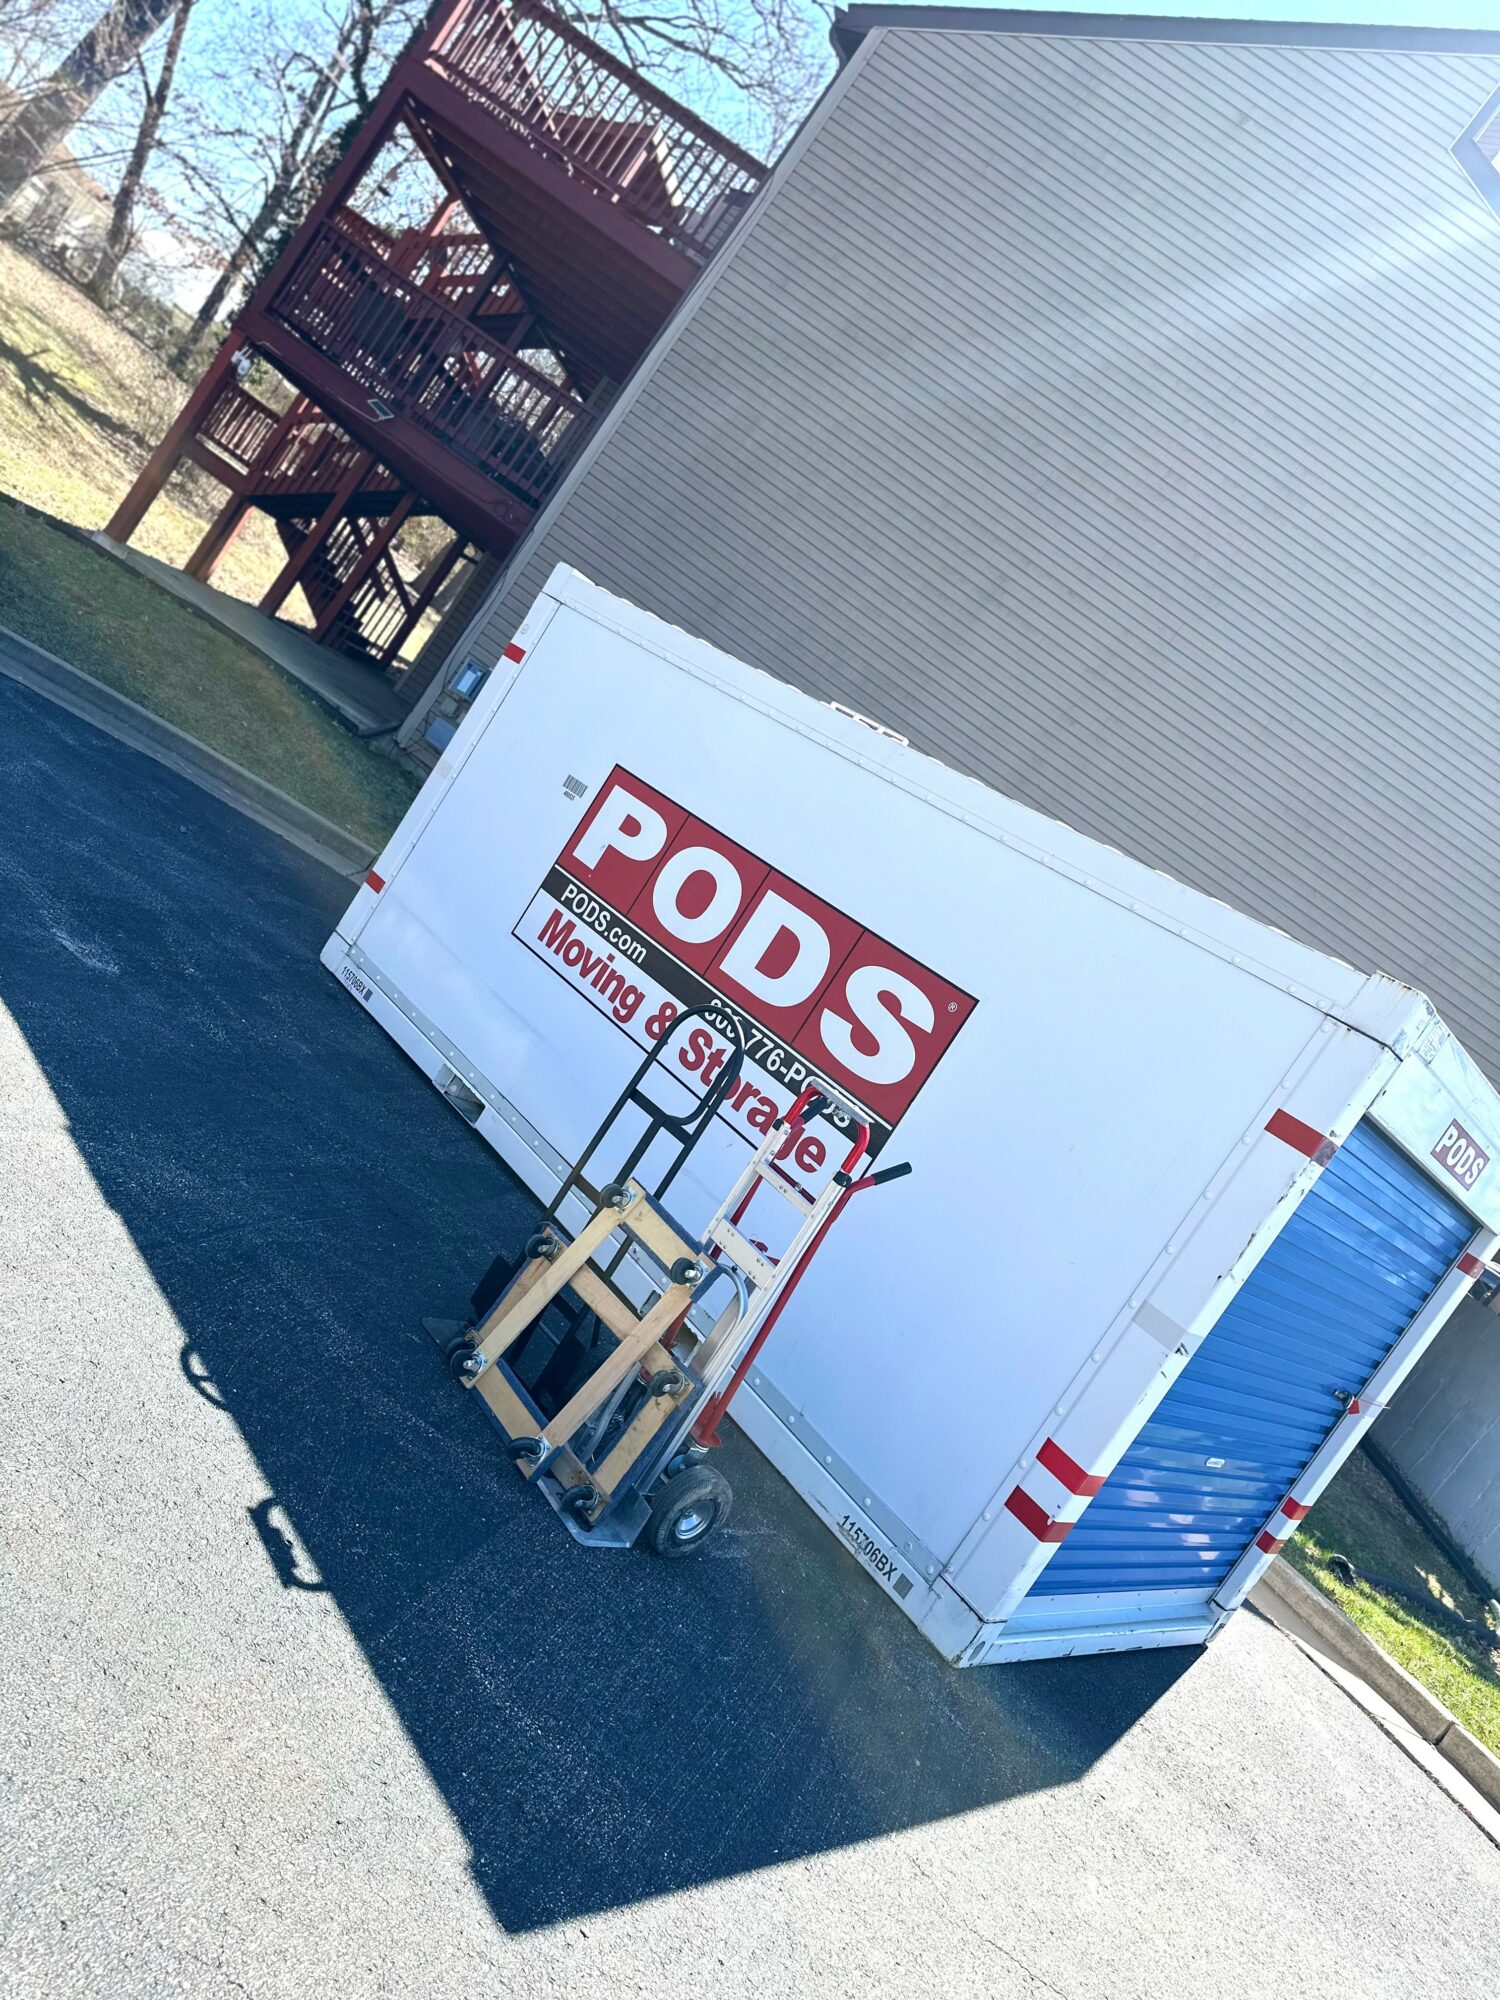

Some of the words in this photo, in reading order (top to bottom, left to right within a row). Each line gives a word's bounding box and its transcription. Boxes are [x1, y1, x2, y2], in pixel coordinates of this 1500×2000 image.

[560, 883, 647, 964] PODS.com
[572, 784, 935, 1086] PODS
[341, 966, 367, 995] 115706BX
[536, 908, 646, 1024] Moving
[645, 1001, 678, 1041] &
[1434, 1124, 1485, 1185] PODS
[840, 1514, 898, 1582] 115706BX
